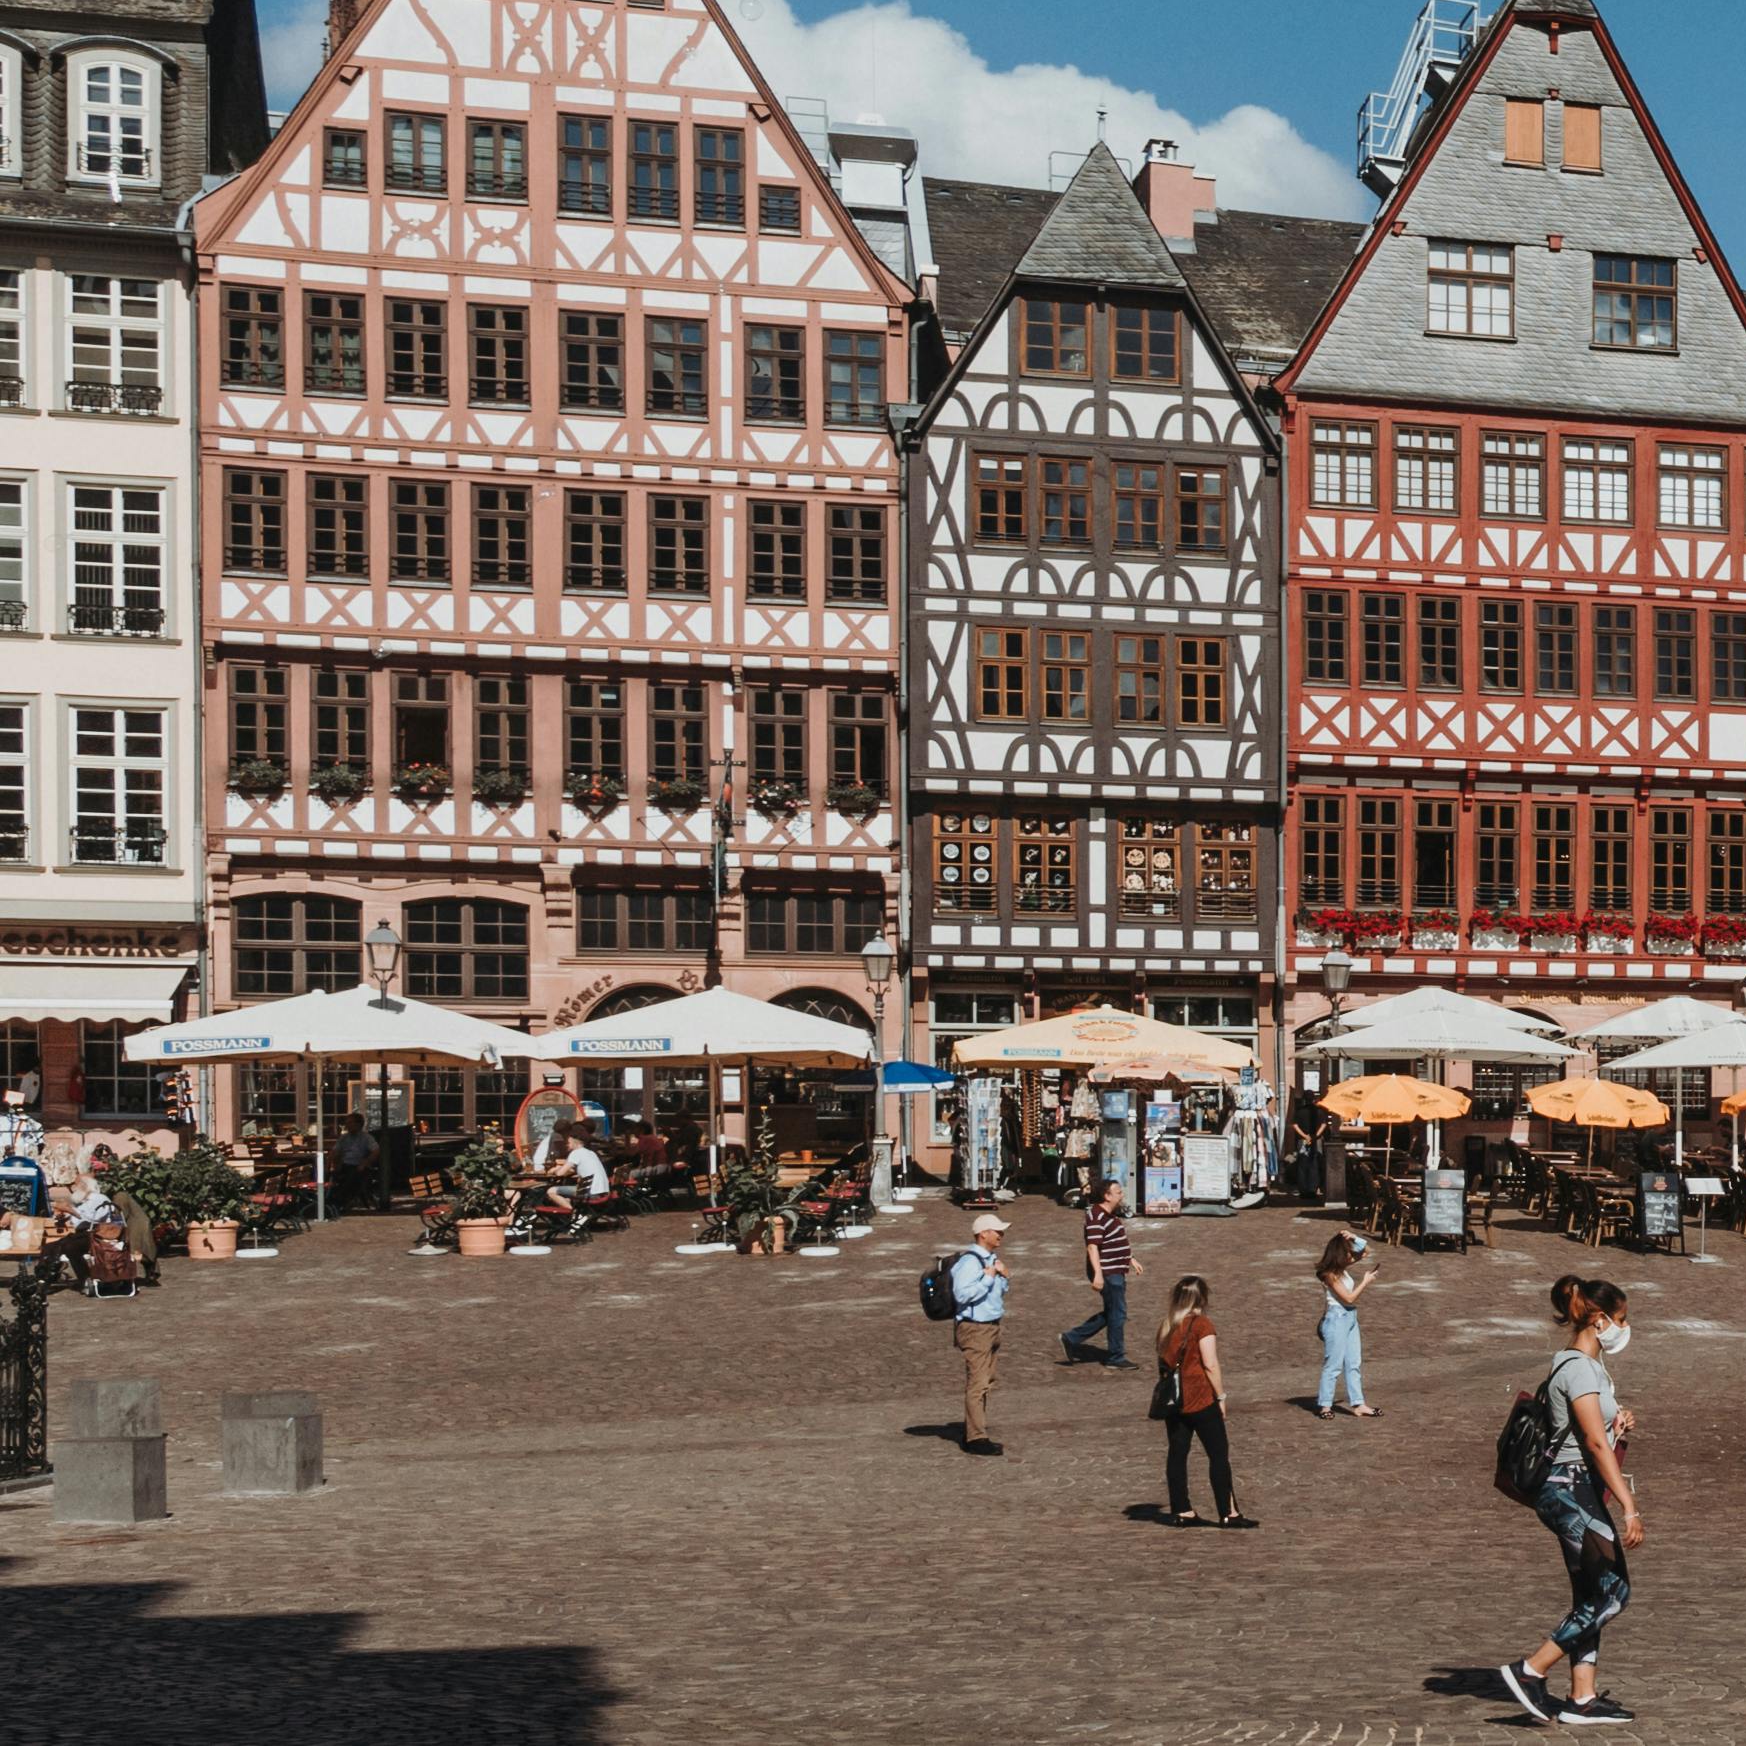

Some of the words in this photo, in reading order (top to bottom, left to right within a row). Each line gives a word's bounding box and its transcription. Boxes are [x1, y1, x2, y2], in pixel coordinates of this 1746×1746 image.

[552, 973, 614, 1029] Römer
[171, 1038, 263, 1052] POSSMANN
[578, 1038, 665, 1052] POSSMANN
